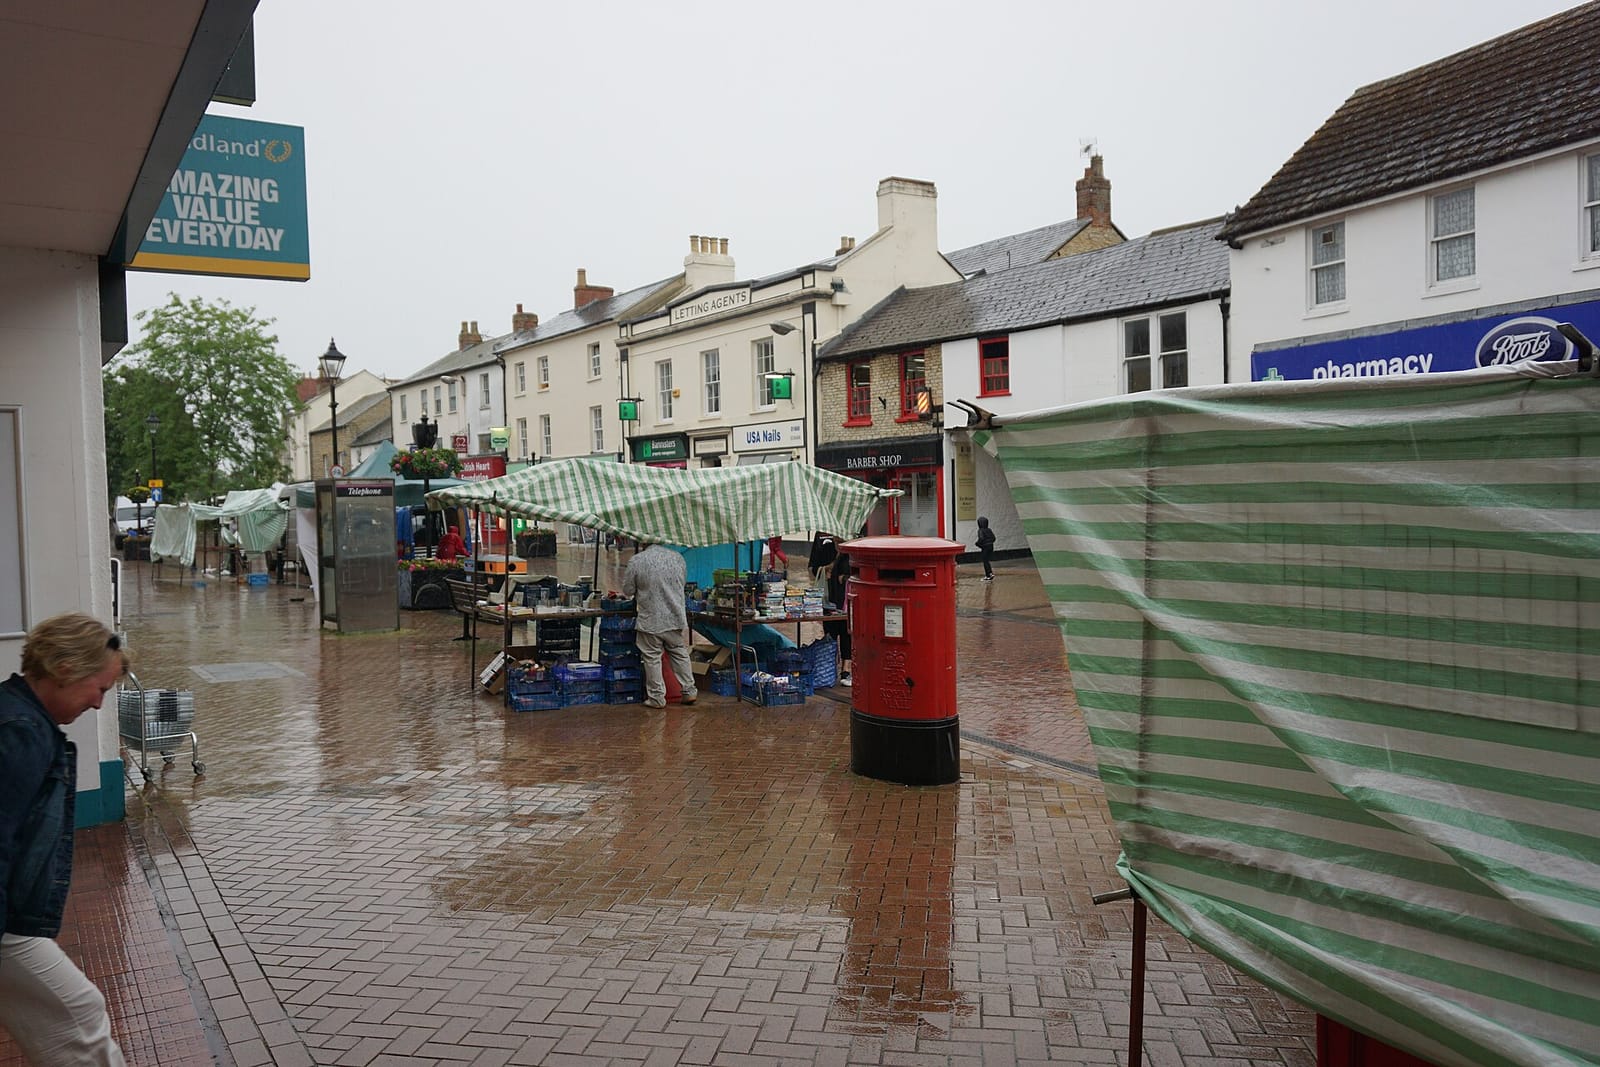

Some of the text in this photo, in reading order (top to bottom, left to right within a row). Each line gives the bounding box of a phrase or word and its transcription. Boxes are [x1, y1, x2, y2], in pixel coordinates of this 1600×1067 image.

[188, 134, 259, 157] dland
[166, 170, 278, 202] MAZING
[172, 195, 260, 225] VALUE
[146, 219, 284, 250] EVERYDAY
[675, 291, 747, 320] LETTING AGENTS
[1491, 330, 1551, 366] Boots
[1313, 353, 1433, 379] pharmacy
[746, 431, 761, 444] USA
[762, 429, 781, 442] Nails
[475, 462, 490, 471] Heart
[847, 456, 877, 468] BARBER
[879, 454, 902, 466] SHOP
[347, 487, 382, 497] Telephone
